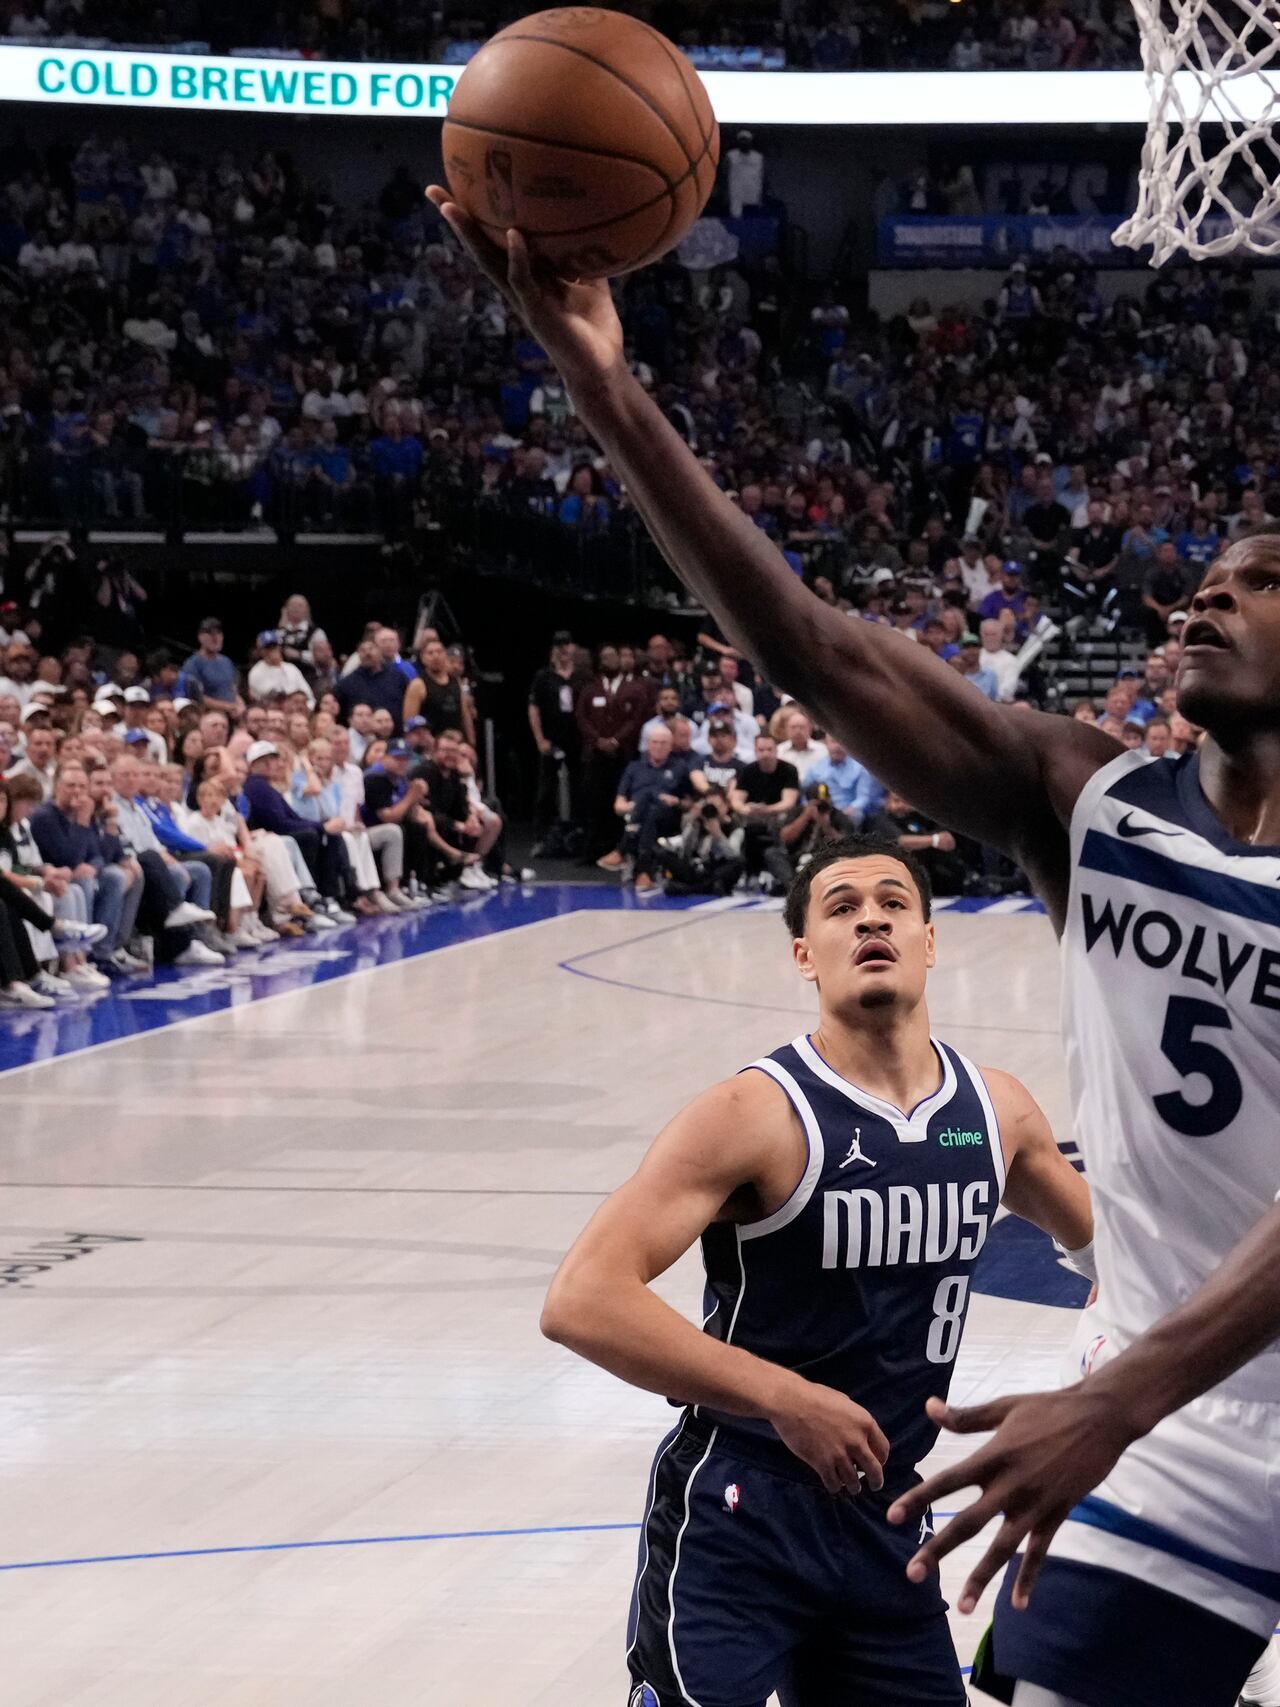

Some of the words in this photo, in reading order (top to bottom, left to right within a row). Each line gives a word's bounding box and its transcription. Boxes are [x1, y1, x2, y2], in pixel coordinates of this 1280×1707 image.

[37, 58, 158, 97] COLD
[170, 65, 357, 106] BREWED
[370, 73, 455, 109] FOR
[1151, 994, 1244, 1138] 5
[938, 1127, 984, 1147] chime
[821, 1180, 990, 1269] MAVS
[925, 1275, 970, 1364] 8
